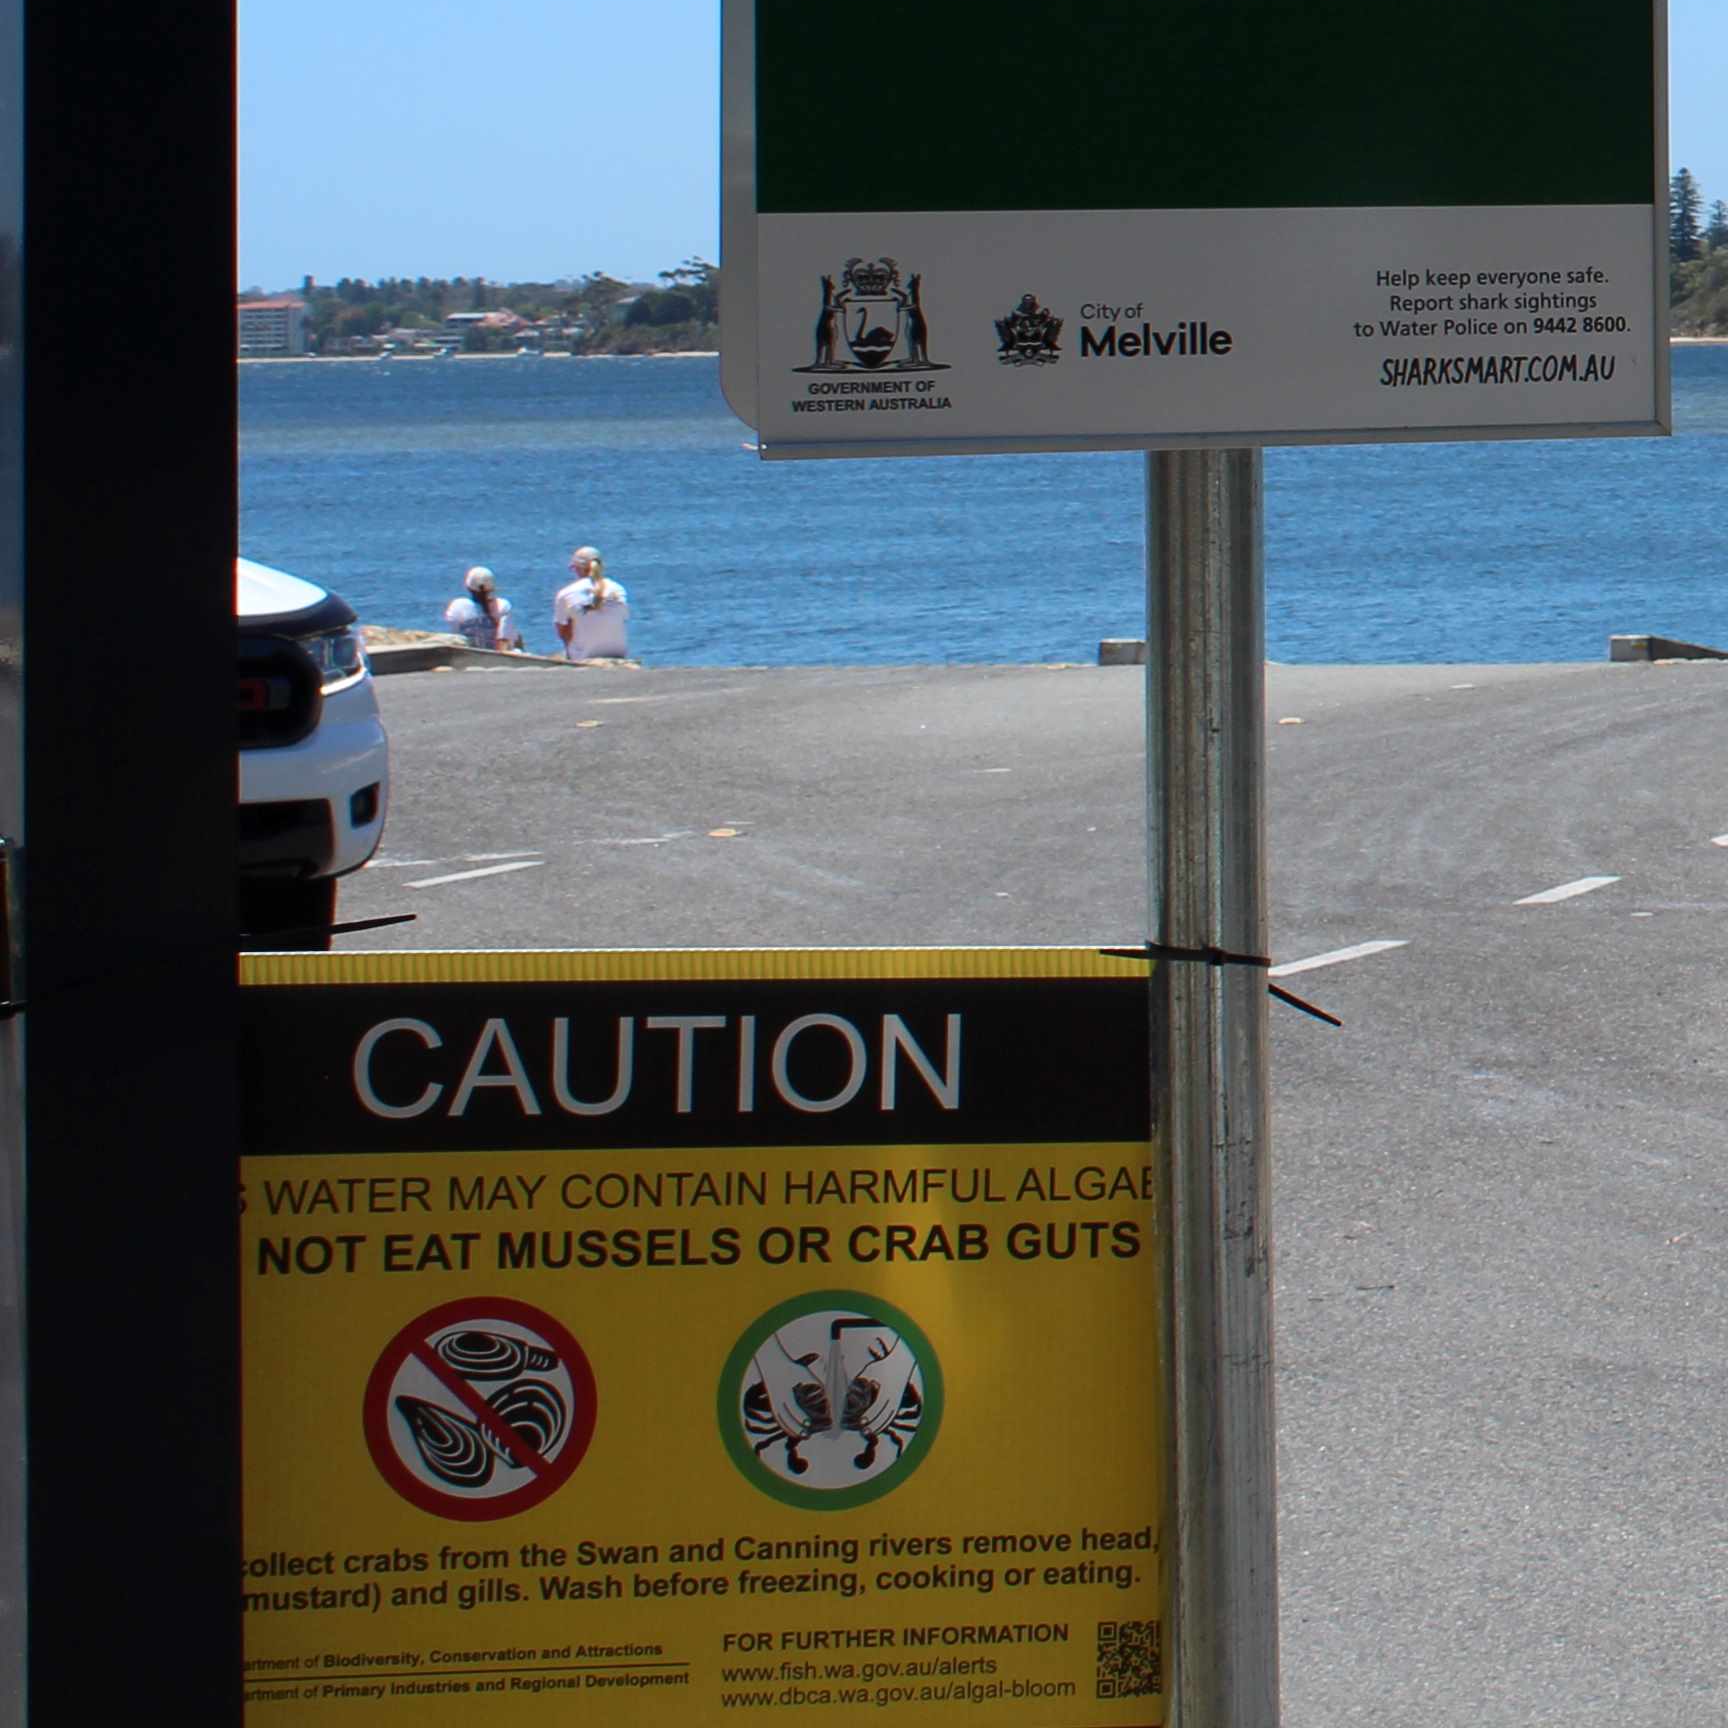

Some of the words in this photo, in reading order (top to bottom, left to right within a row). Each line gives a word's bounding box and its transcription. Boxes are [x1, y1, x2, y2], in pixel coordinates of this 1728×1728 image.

[1377, 270, 1419, 290] Help
[1426, 269, 1471, 289] keep
[1477, 272, 1561, 288] everyone
[1567, 266, 1608, 283] safe.
[1080, 304, 1121, 321] City
[1125, 303, 1143, 319] of
[1390, 295, 1453, 315] Report
[1459, 293, 1508, 310] shark
[1515, 292, 1596, 313] sightings
[1081, 322, 1232, 357] Melville
[1354, 323, 1374, 337] to
[1380, 321, 1437, 336] Water
[1444, 318, 1497, 335] Police
[1504, 322, 1527, 334] on
[1534, 317, 1576, 333] 9442
[1583, 316, 1630, 332] 8600.
[1380, 354, 1615, 387] SHARKSMART.COM.AU
[808, 381, 911, 395] GOVERNMENT
[915, 380, 935, 392] OF
[792, 400, 865, 412] WESTERN
[869, 397, 951, 410] AUSTRALIA
[354, 1013, 961, 1118] CAUTION
[263, 1177, 431, 1215] WATER
[450, 1175, 546, 1211] MAY
[562, 1172, 766, 1209] CONTAIN
[785, 1168, 1006, 1204] HARMFUL
[258, 1236, 366, 1275] NOT
[384, 1233, 480, 1271] EAT
[498, 1228, 740, 1269] MUSSELS
[759, 1227, 830, 1264] OR
[848, 1224, 989, 1262] CRAB
[1007, 1221, 1140, 1260] GUTS
[344, 1548, 428, 1573] crabs
[439, 1546, 508, 1569] from
[520, 1543, 566, 1567] the
[577, 1541, 658, 1565] Swan
[669, 1538, 723, 1562] and
[735, 1535, 858, 1563] Canning
[870, 1533, 952, 1556] rivers
[963, 1534, 1071, 1553] remove
[1081, 1527, 1159, 1555] head,
[392, 1581, 447, 1606] and
[458, 1578, 528, 1610] gills.
[540, 1575, 622, 1600] Wash
[634, 1572, 728, 1597] before
[738, 1568, 865, 1597] freezing,
[876, 1565, 993, 1593] cooking
[1005, 1568, 1035, 1586] or
[1044, 1561, 1140, 1589] eating.
[724, 1633, 772, 1652] FOR
[782, 1629, 895, 1650] FURTHER
[903, 1624, 1068, 1645] INFORMATION
[304, 1655, 320, 1668] of
[324, 1653, 424, 1668] Biodiversity,
[430, 1648, 536, 1663] Conservation
[541, 1646, 570, 1659] and
[576, 1644, 662, 1658] Attractions
[722, 1657, 997, 1682] www.fish.wa.gov.au/alerts
[303, 1685, 319, 1699] of
[322, 1685, 385, 1698] Primary
[391, 1681, 470, 1694] Industries
[476, 1678, 505, 1691] and
[511, 1676, 580, 1692] Regional
[585, 1672, 689, 1688] Development
[721, 1679, 1075, 1707] www.dbca.wa.gov.au/algal-bloom
